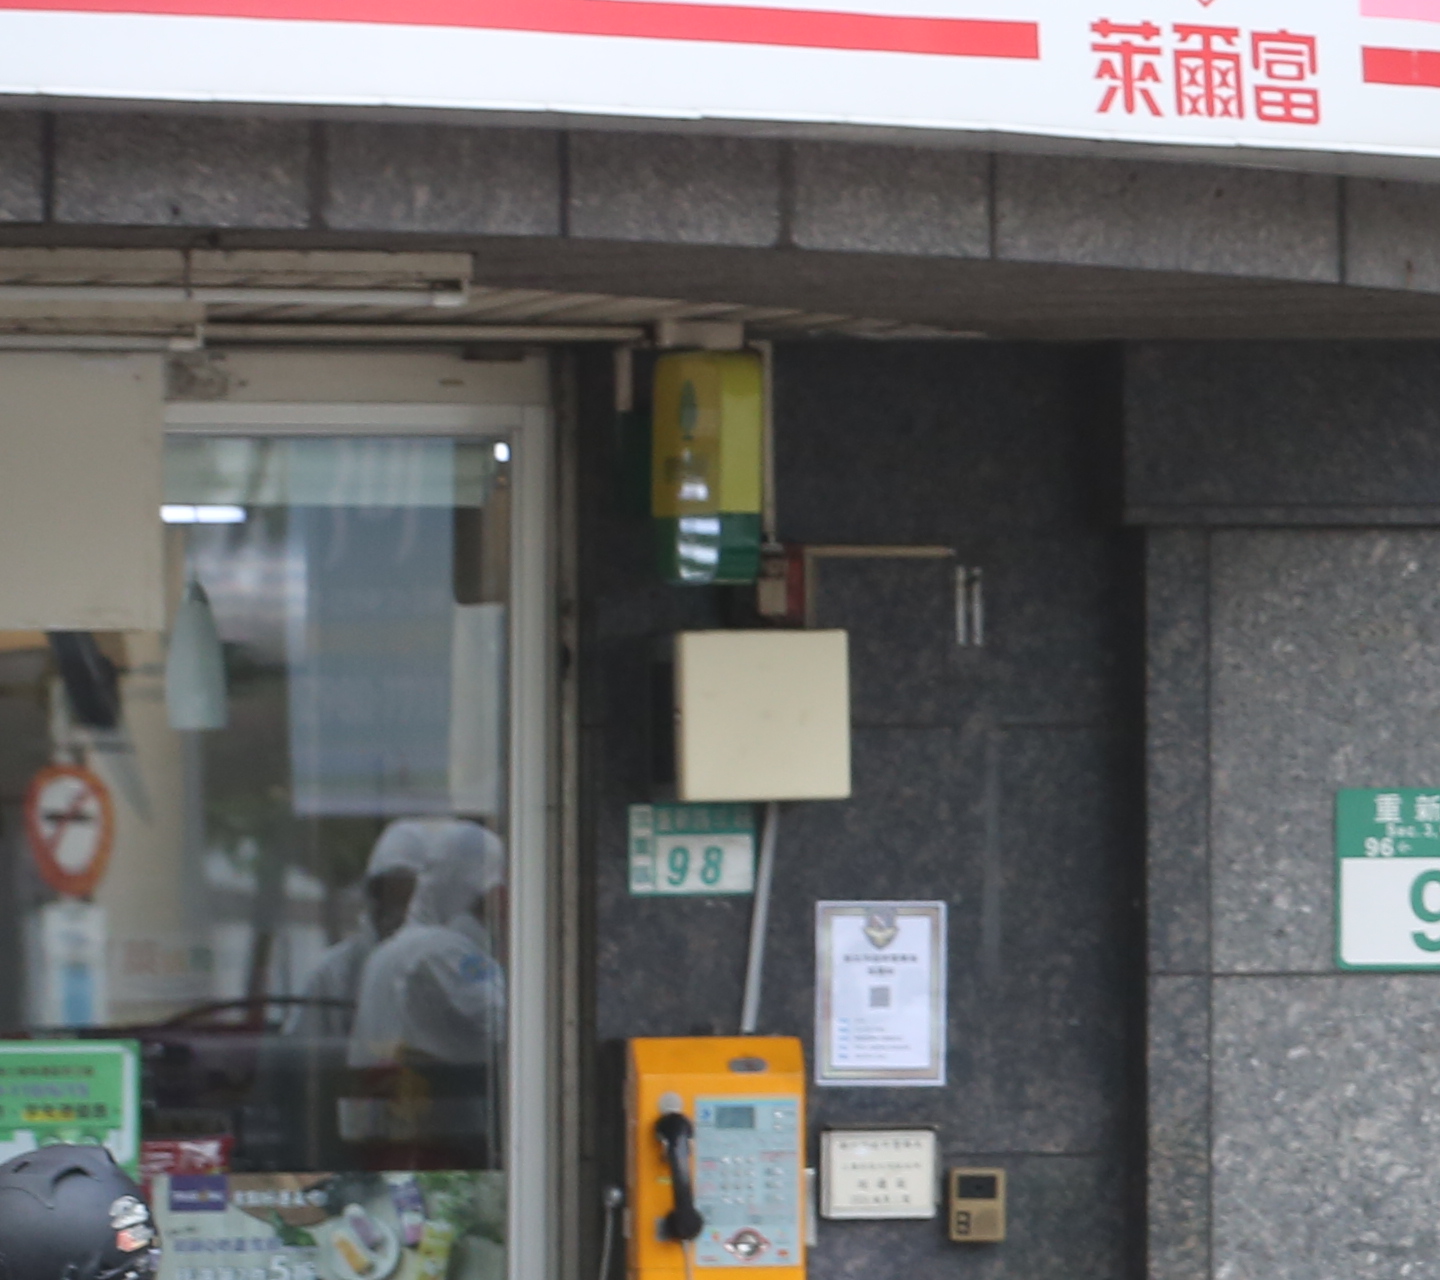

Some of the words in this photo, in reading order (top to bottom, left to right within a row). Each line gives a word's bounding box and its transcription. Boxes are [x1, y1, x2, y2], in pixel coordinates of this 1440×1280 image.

[1090, 16, 1320, 124] 萊爾富
[666, 844, 725, 887] 98
[1363, 837, 1395, 857] 96
